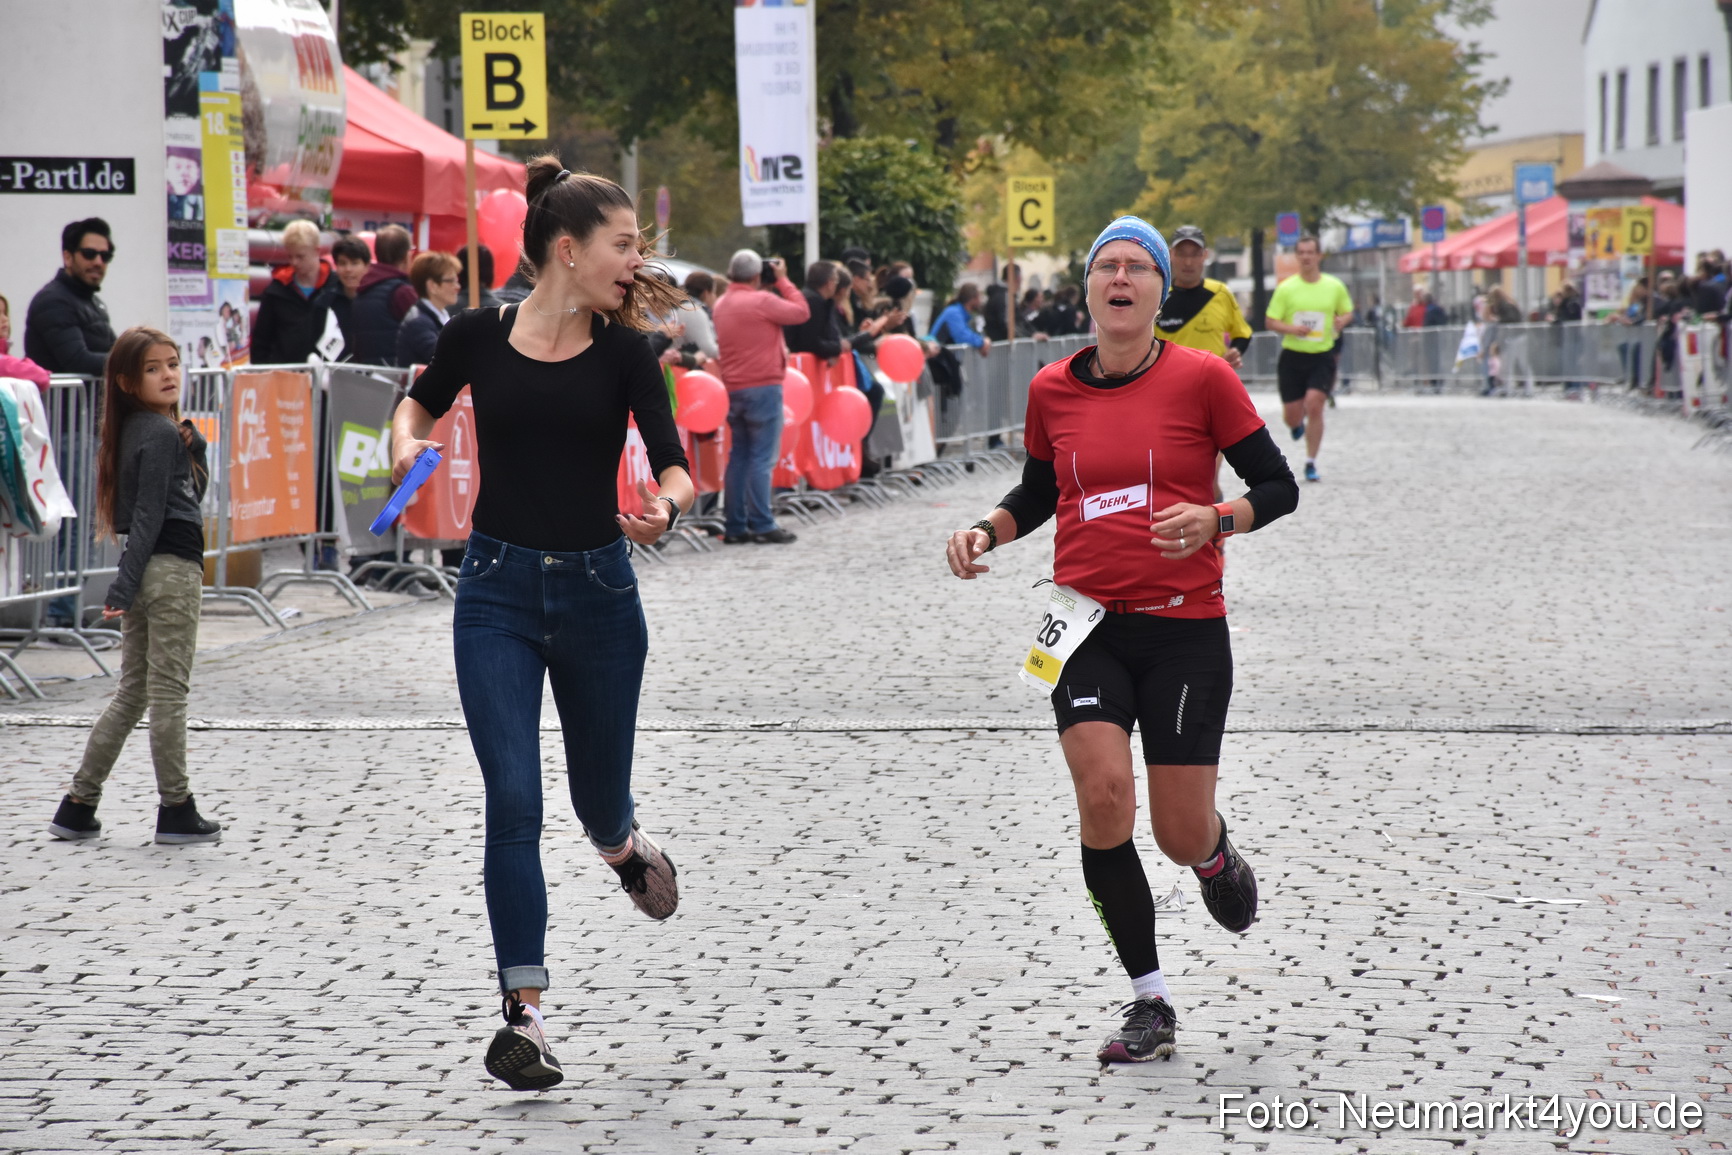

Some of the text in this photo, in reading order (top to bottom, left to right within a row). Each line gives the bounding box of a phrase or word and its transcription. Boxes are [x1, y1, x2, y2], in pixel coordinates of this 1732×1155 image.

[472, 19, 534, 41] Block
[485, 53, 525, 111] B
[204, 111, 230, 136] 18.
[1013, 181, 1047, 193] Block
[1019, 197, 1042, 231] C
[1631, 220, 1648, 244] D
[1099, 494, 1129, 510] DEHN
[1036, 610, 1068, 648] 26
